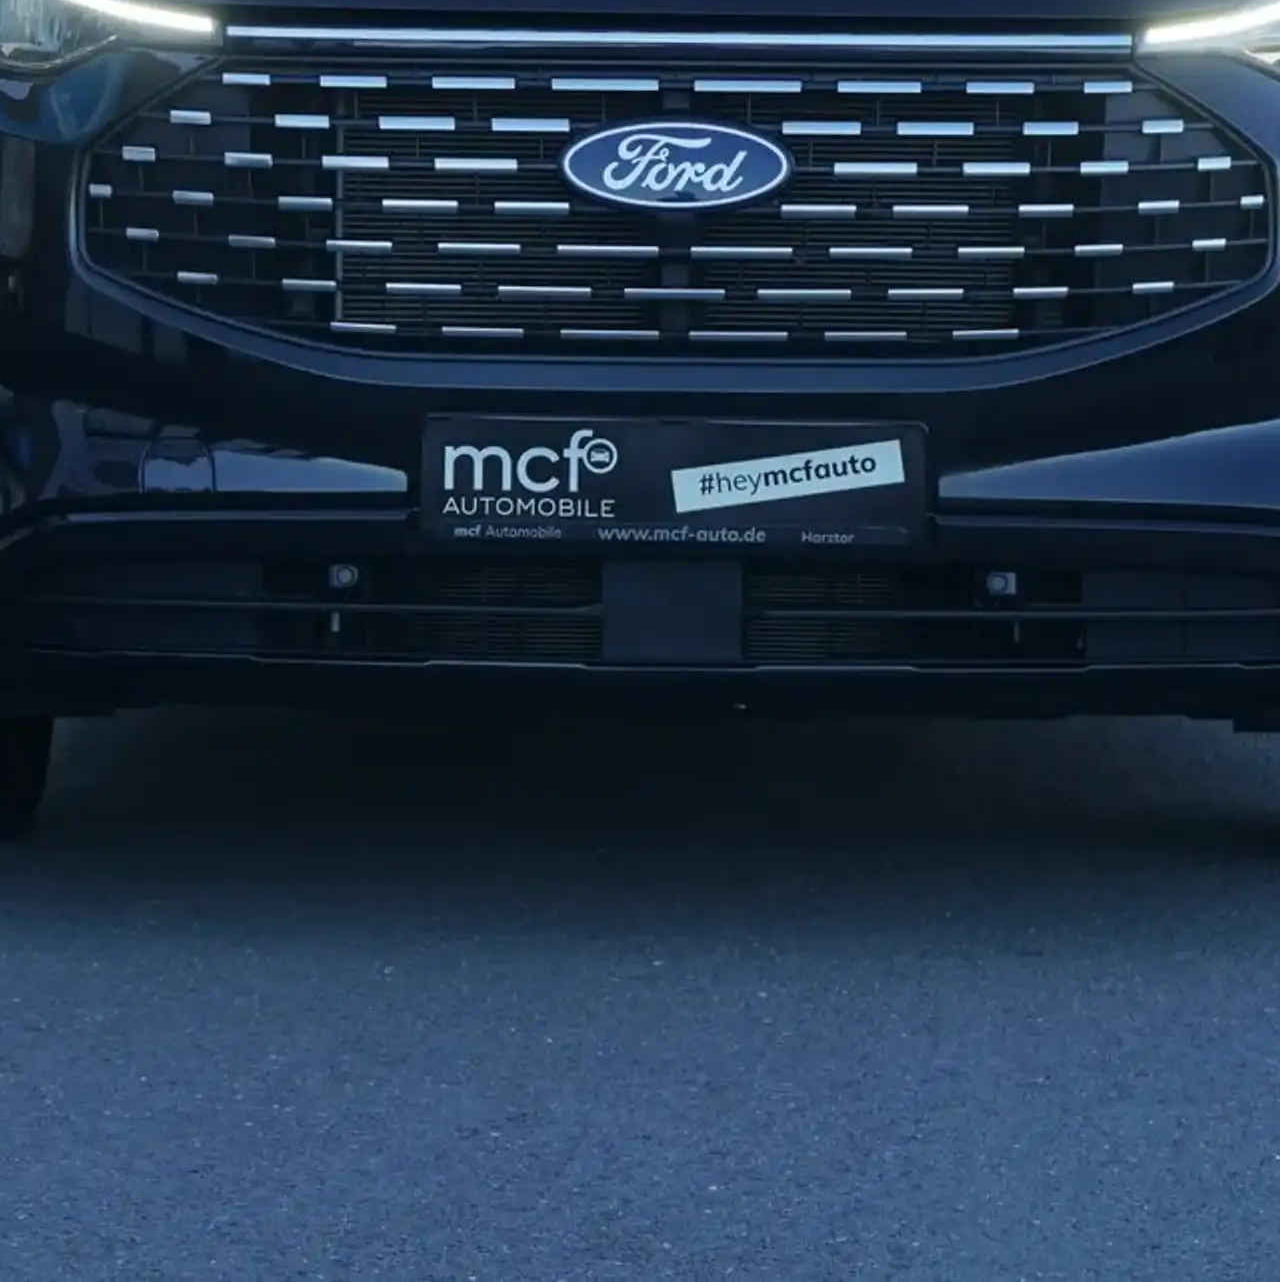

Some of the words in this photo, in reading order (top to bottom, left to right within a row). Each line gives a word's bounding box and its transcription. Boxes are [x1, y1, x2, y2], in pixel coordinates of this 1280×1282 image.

[602, 133, 748, 192] Ford
[443, 428, 595, 493] mcf
[698, 454, 878, 495] #heymcfauto
[442, 496, 616, 518] AUTOMOBILE
[454, 524, 481, 537] mcf
[485, 525, 562, 539] Automobile
[598, 526, 767, 543] www.mcf-auto.de
[801, 530, 855, 544] Harztor
